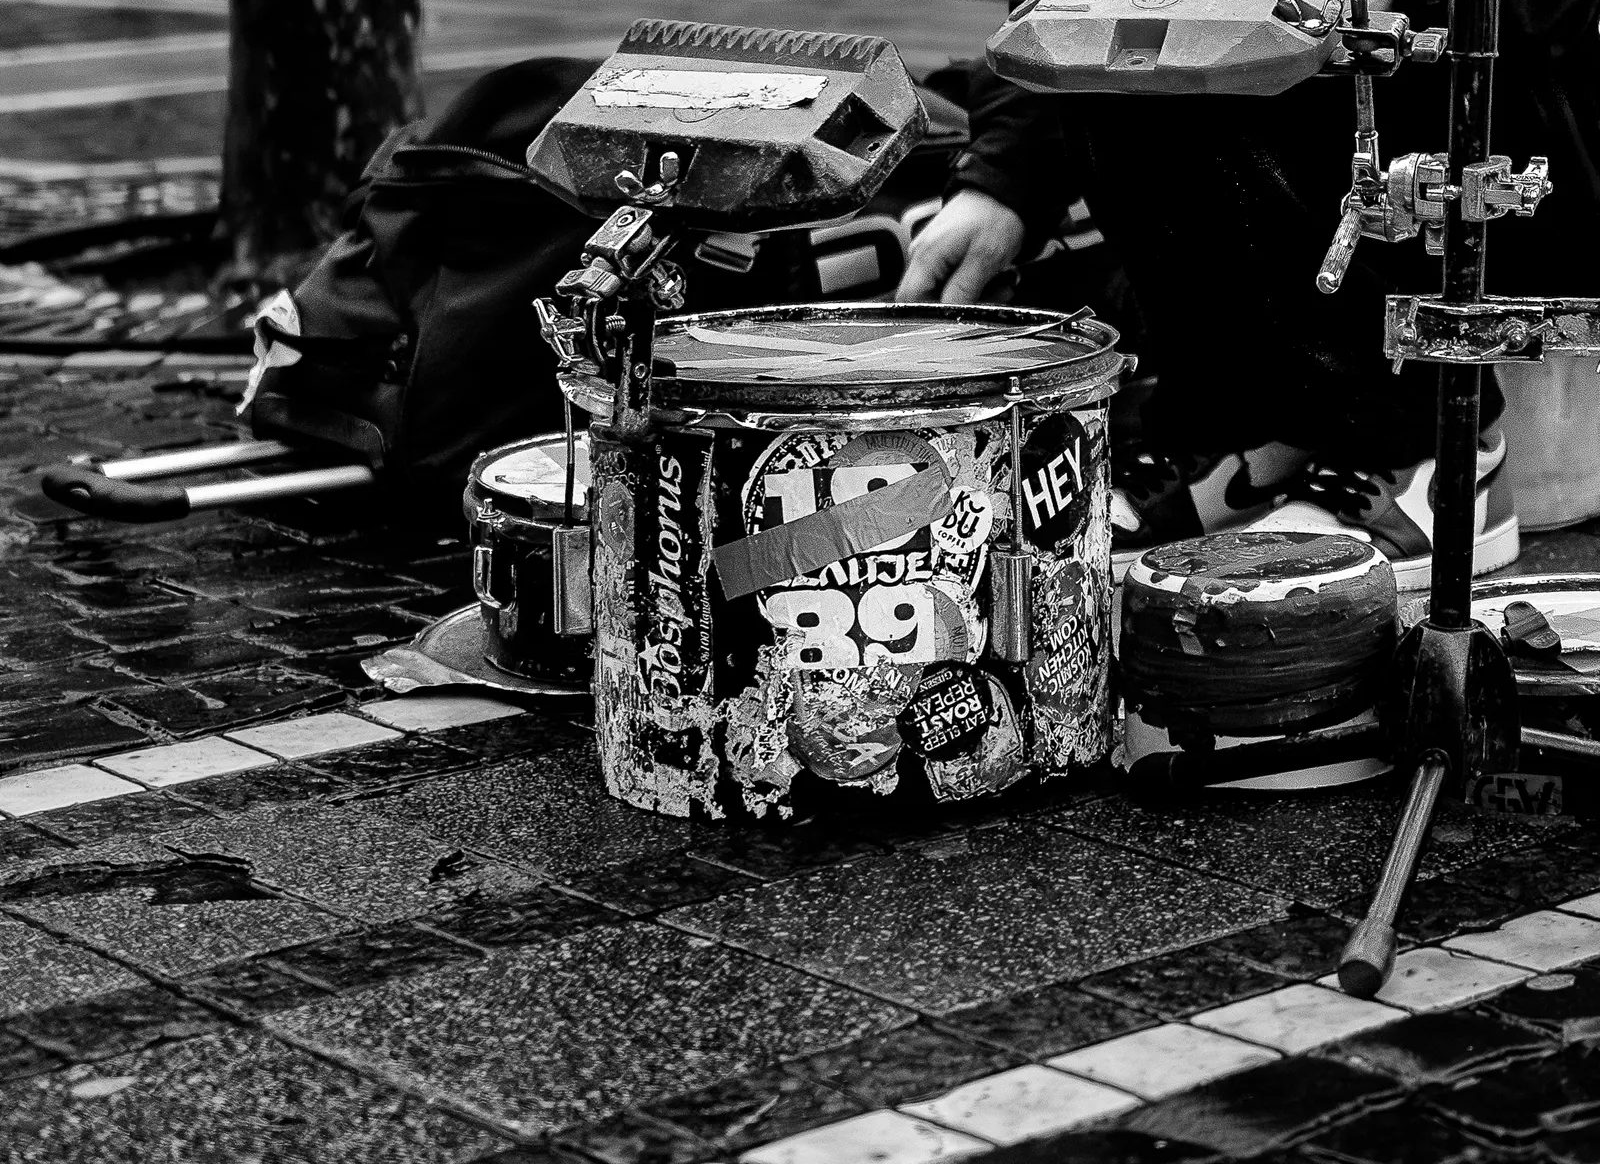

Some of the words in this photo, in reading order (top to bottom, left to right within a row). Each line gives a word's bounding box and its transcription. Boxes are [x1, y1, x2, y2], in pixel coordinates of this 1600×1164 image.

[1021, 436, 1083, 529] HEY
[941, 511, 980, 538] DU
[766, 584, 936, 669] 89
[1050, 616, 1077, 651] COM
[1039, 624, 1088, 682] KITCHEN
[1048, 642, 1091, 695] KOSMIC
[909, 675, 976, 722] REPEAT.
[916, 694, 982, 738] ROAST.
